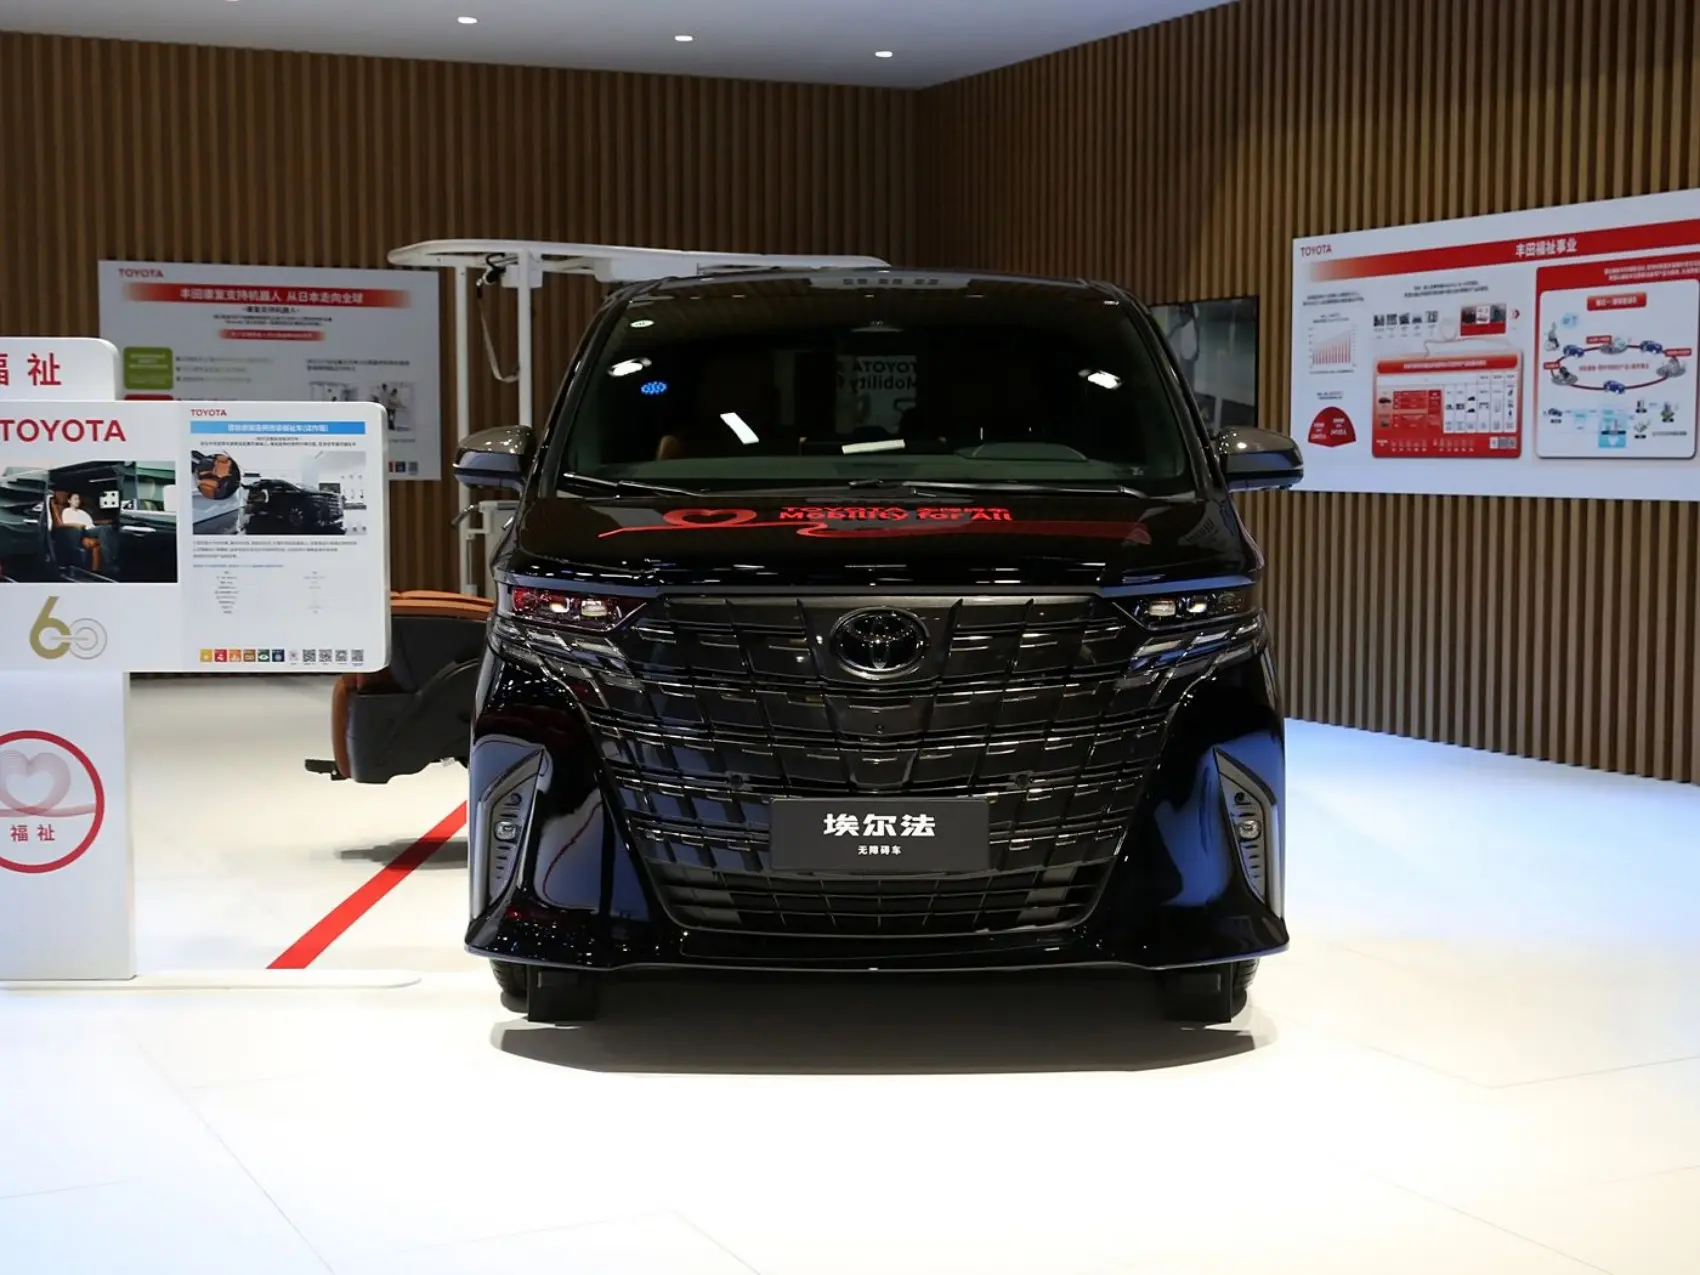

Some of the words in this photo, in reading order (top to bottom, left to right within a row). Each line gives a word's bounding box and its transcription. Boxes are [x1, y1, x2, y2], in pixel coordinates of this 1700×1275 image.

[1300, 244, 1332, 257] TOYOTA
[1516, 238, 1577, 257] 丰田福祉事业
[118, 268, 164, 278] TOYOTA
[0, 352, 62, 386] 祉
[190, 409, 227, 417] TOYOTA
[0, 419, 126, 442] TOYOTA
[10, 824, 56, 842] 福祉
[823, 813, 936, 837] 埃尔法
[858, 845, 902, 856] 无障碍车
